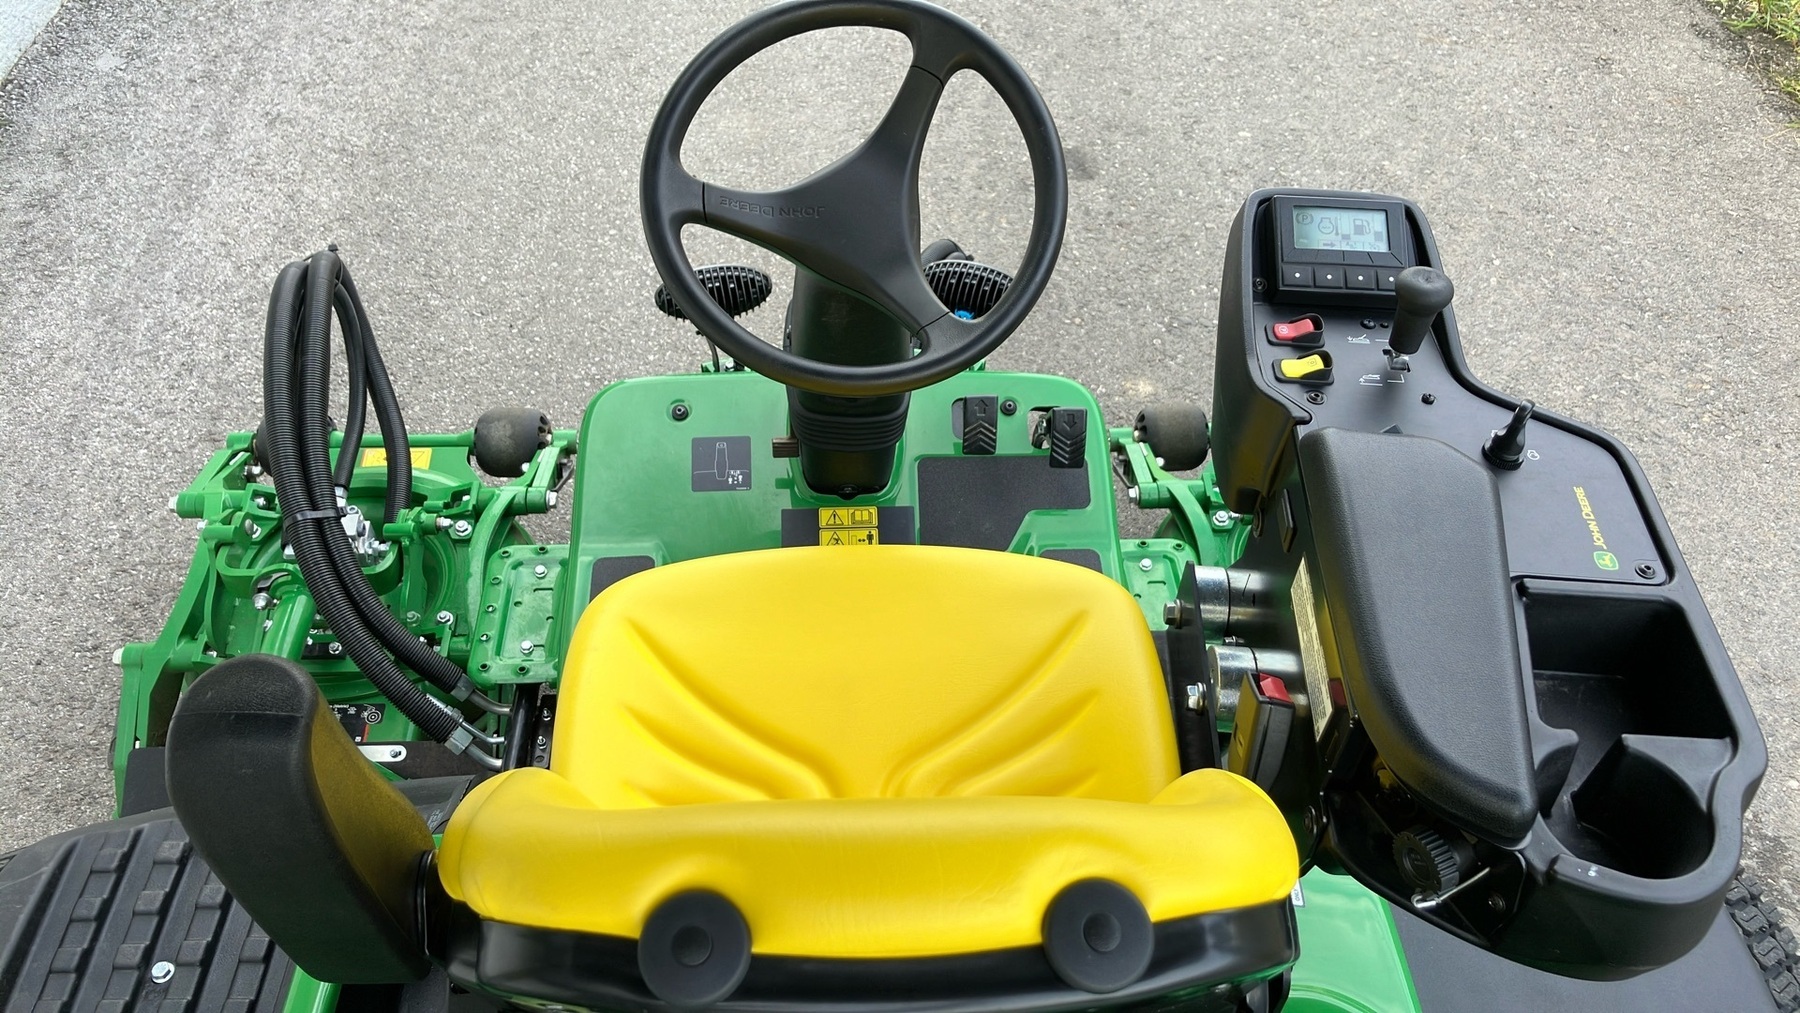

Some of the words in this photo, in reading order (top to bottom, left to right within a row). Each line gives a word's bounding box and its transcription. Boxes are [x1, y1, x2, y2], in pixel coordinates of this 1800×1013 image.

[720, 196, 774, 218] DEERE
[779, 206, 826, 219] JOHN
[1573, 486, 1595, 520] DEERE
[1586, 520, 1608, 550] JOHN
